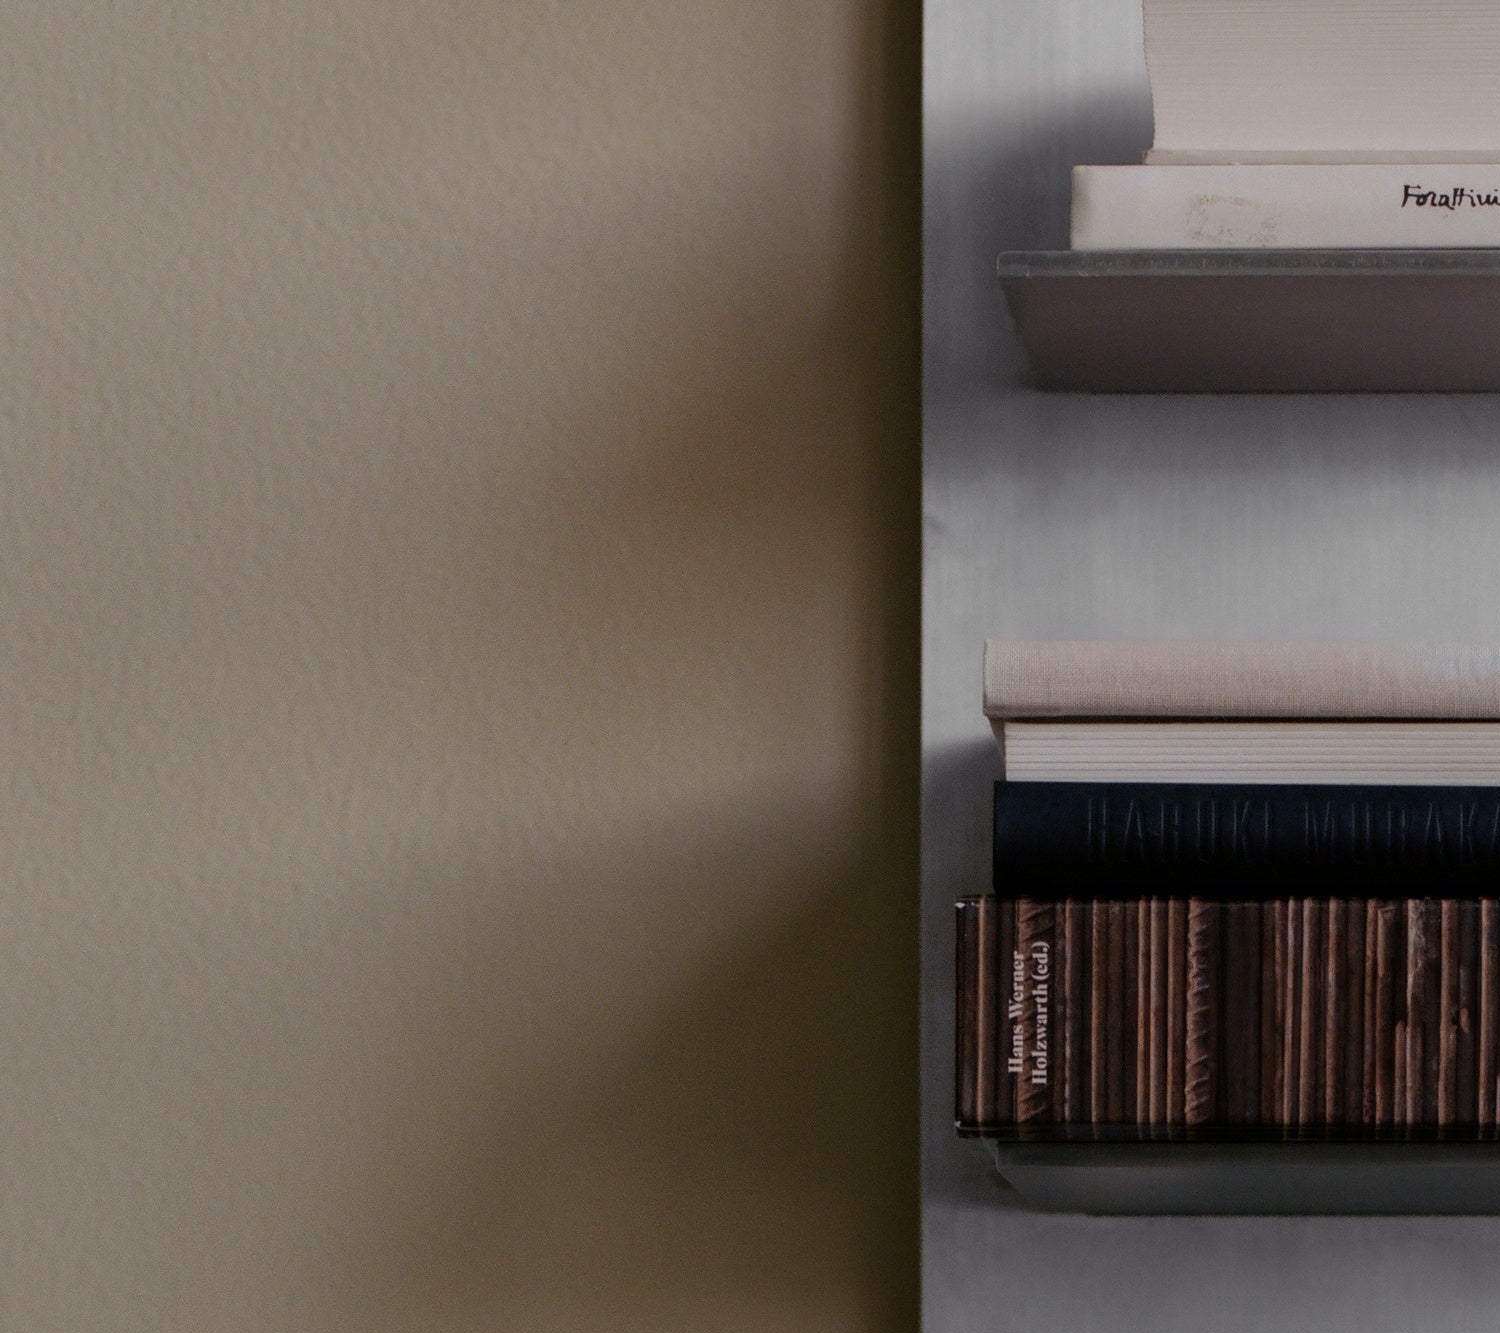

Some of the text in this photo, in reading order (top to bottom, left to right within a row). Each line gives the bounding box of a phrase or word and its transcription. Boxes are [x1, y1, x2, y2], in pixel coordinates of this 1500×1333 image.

[1086, 797, 1275, 865] HARUKI
[1008, 951, 1025, 1073] Hans Werner
[1031, 941, 1050, 1085] Holzwarth (ed.)
